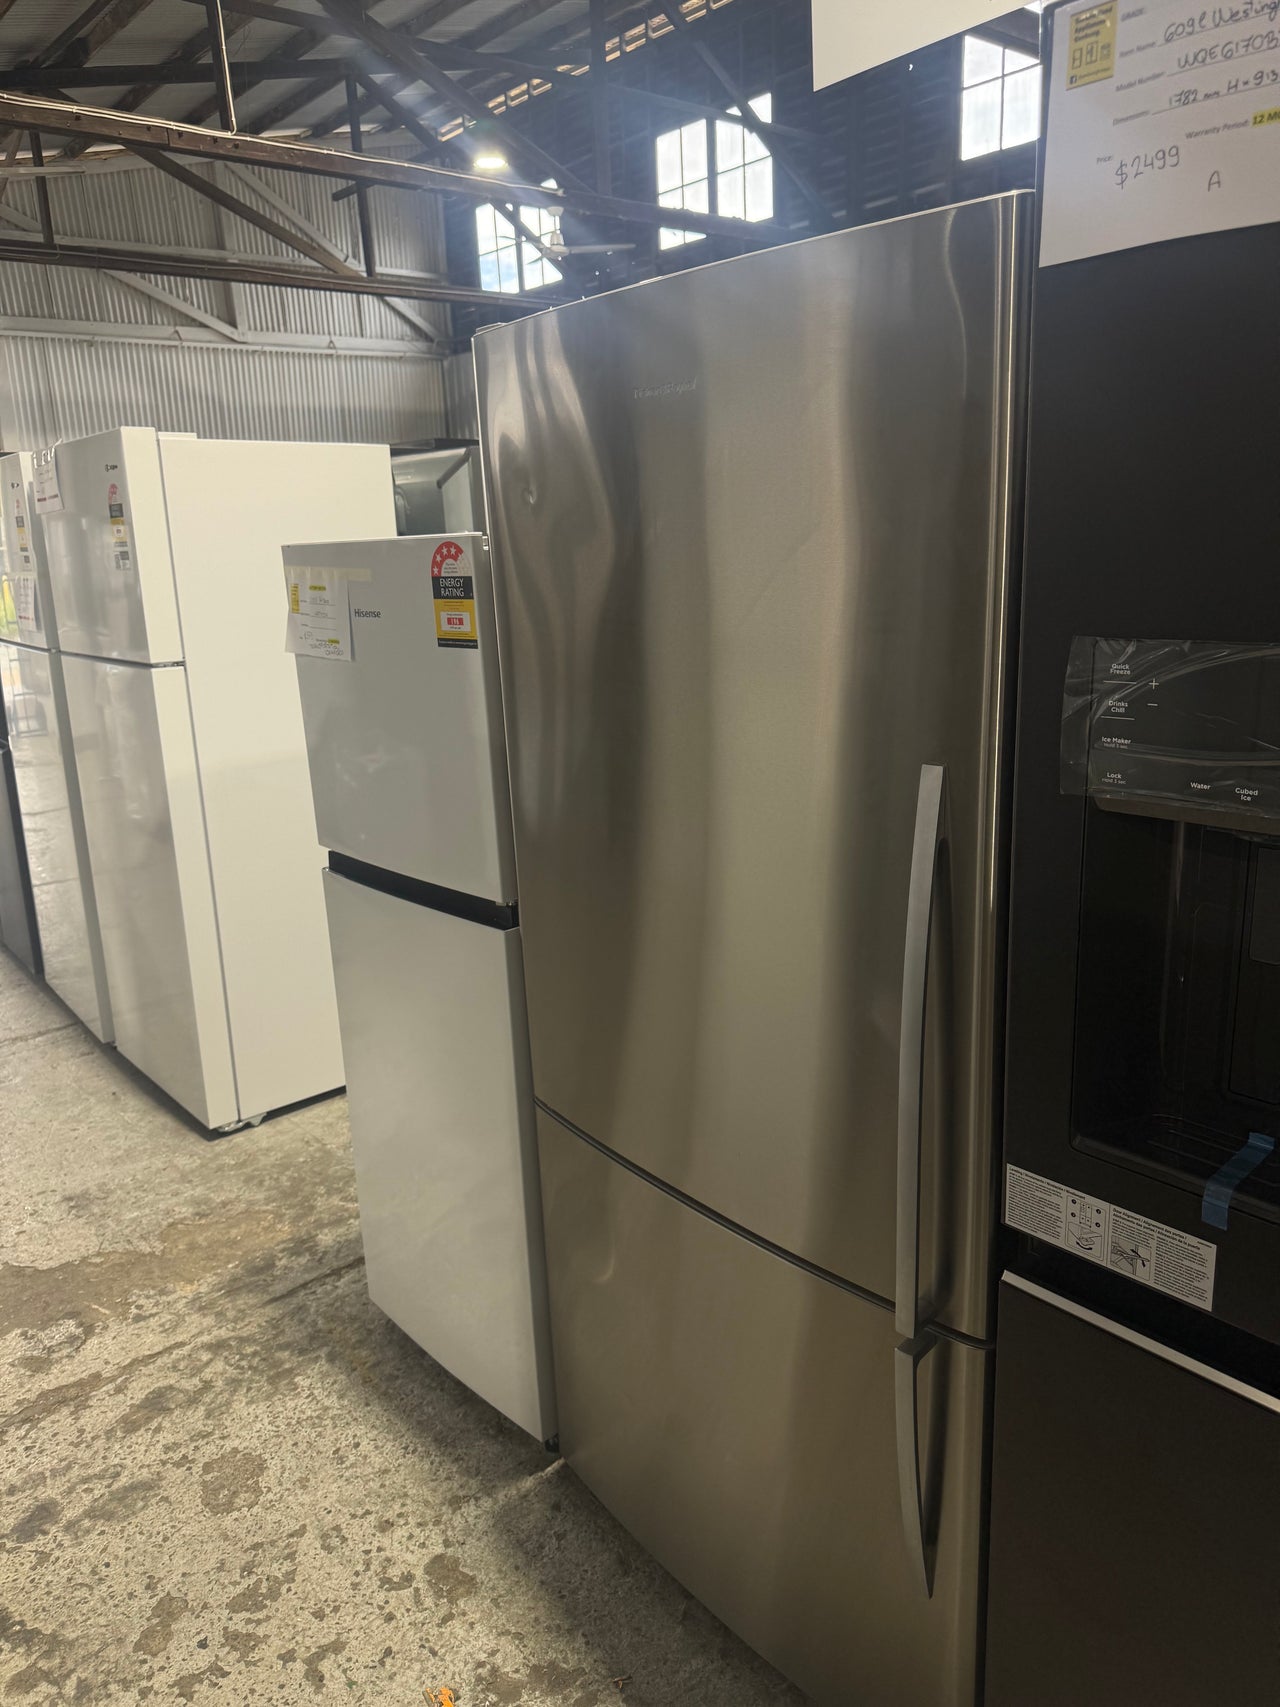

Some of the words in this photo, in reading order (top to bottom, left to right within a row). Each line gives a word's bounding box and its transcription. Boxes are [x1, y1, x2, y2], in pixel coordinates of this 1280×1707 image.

[1178, 30, 1280, 69] WQE6170B
[1186, 126, 1221, 140] Warranty
[1252, 114, 1265, 126] 12
[1115, 145, 1180, 189] $2499
[1207, 170, 1222, 192] A
[440, 578, 464, 587] ENERGY
[440, 588, 465, 597] RATING
[354, 608, 381, 618] Hisense
[1111, 663, 1130, 671] Quick
[1108, 700, 1128, 708] Drinks
[1190, 782, 1211, 790] Water
[1235, 787, 1259, 796] Cubed
